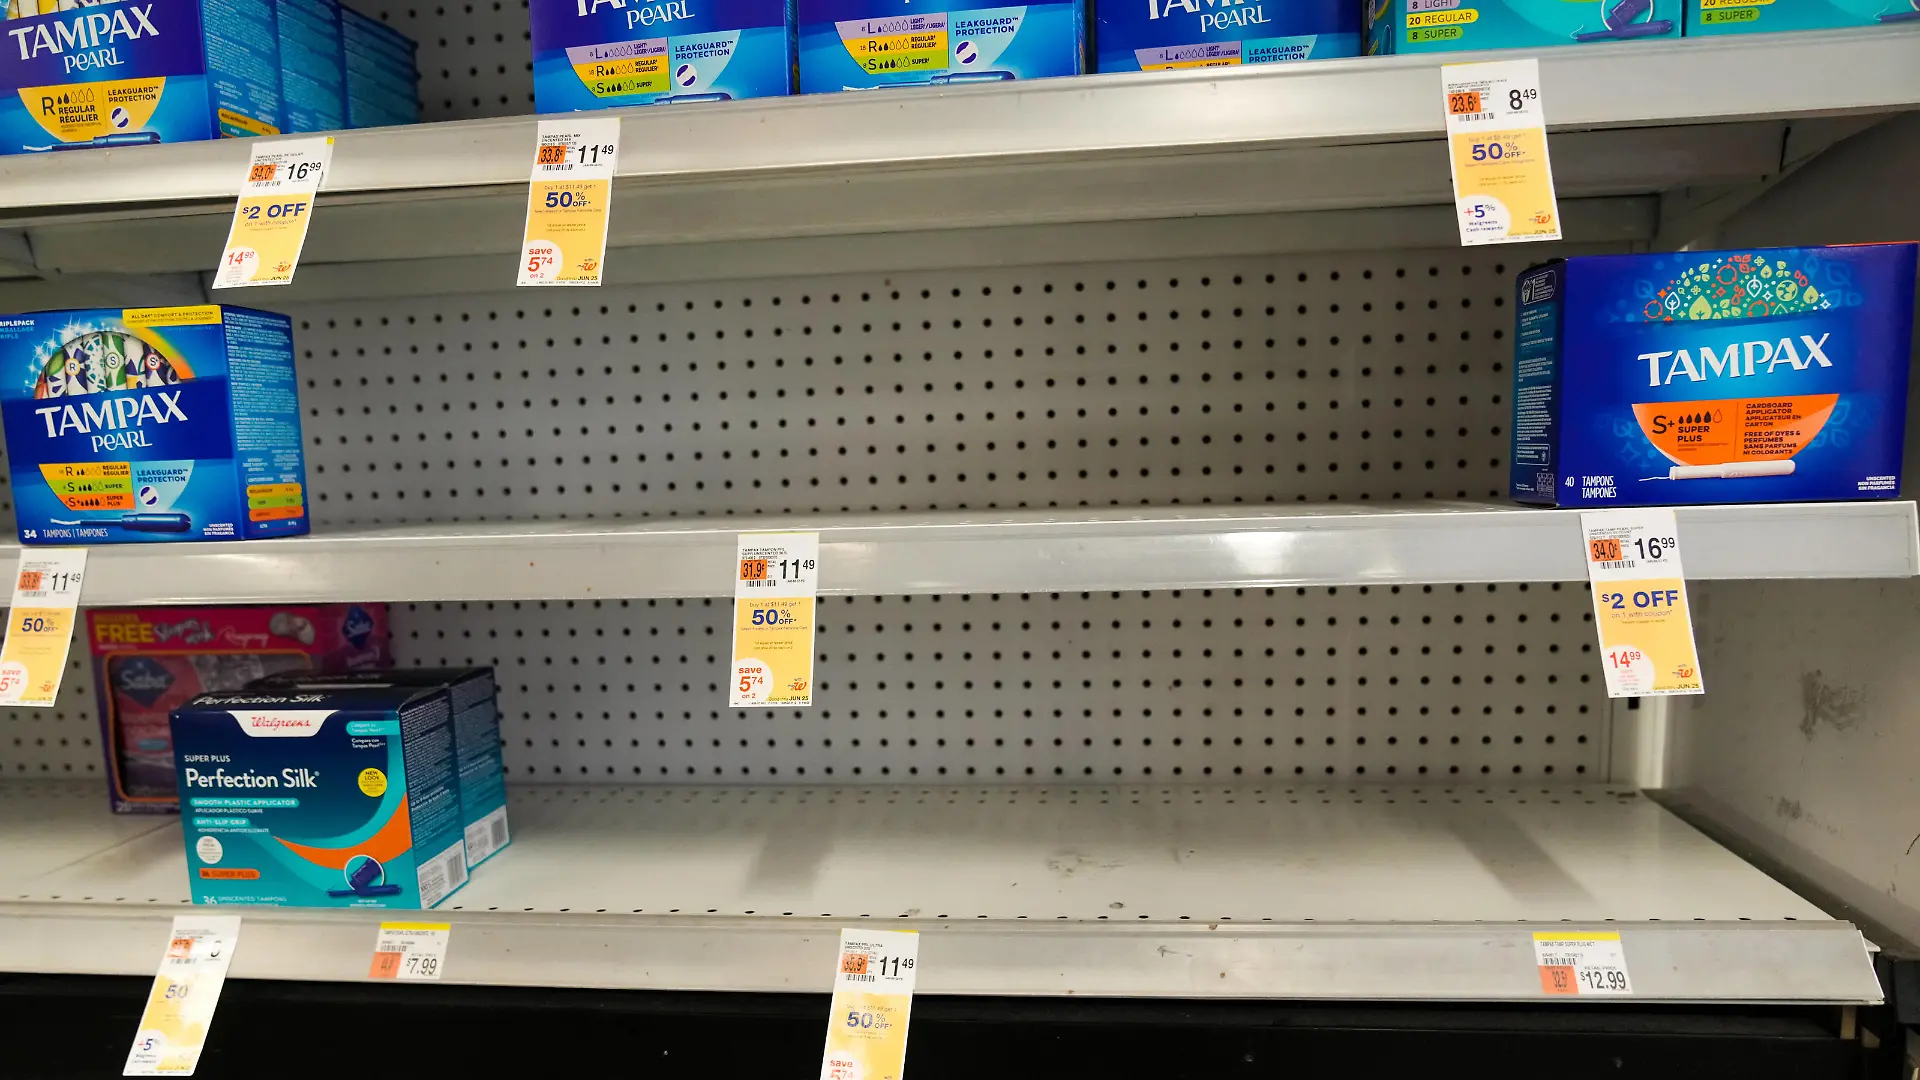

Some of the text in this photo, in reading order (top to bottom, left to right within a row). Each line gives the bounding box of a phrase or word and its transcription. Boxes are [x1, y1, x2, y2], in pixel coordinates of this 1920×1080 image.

[1412, 0, 1452, 9] 8 LIGHT
[1409, 12, 1472, 25] 20 REGULAR
[1706, 10, 1753, 22] 8 SUPER
[8, 3, 160, 60] TAMPAX
[867, 22, 876, 34] L
[955, 25, 1015, 37] PROTECTION
[1412, 28, 1457, 40] 8 SUPER
[868, 40, 877, 53] R
[595, 47, 603, 59] L
[675, 48, 731, 61] PROTECTION
[1165, 49, 1173, 61] L
[1248, 52, 1305, 63] PROTECTION
[868, 58, 877, 70] S
[596, 65, 605, 76] R
[596, 82, 605, 94] S
[108, 93, 157, 103] PROTECTION
[42, 96, 56, 116] R
[58, 104, 96, 116] REGULAR
[267, 203, 307, 219] OFF
[110, 357, 117, 366] S
[1637, 332, 1833, 388] TAMPAX
[70, 363, 76, 371] R
[1745, 408, 1792, 416] APPLICATOR
[1746, 402, 1793, 410] CARDBOARD
[35, 390, 188, 438] TAMPAX
[1677, 425, 1710, 434] SUPER
[1677, 434, 1703, 443] PLUS
[1751, 448, 1793, 456] COLORANTS
[1765, 442, 1797, 450] PARFUMS
[65, 466, 73, 477] R
[137, 475, 186, 483] PROTECTION
[1564, 475, 1614, 488] 40 TAMPONS
[68, 482, 75, 493] S
[1581, 487, 1617, 499] TAMPONES
[23, 528, 109, 539] 34 TAMPONS TAMPONES
[1632, 590, 1679, 609] OFF
[96, 623, 156, 643] FREE
[193, 694, 288, 706] Perfection
[251, 716, 312, 732] Walgreens
[184, 755, 231, 763] SUPER PLUS
[185, 768, 279, 789] Perfection
[203, 895, 218, 905] 36
[406, 957, 437, 976] $7.99
[1579, 970, 1627, 991] $12.99
[829, 1060, 853, 1068] save
